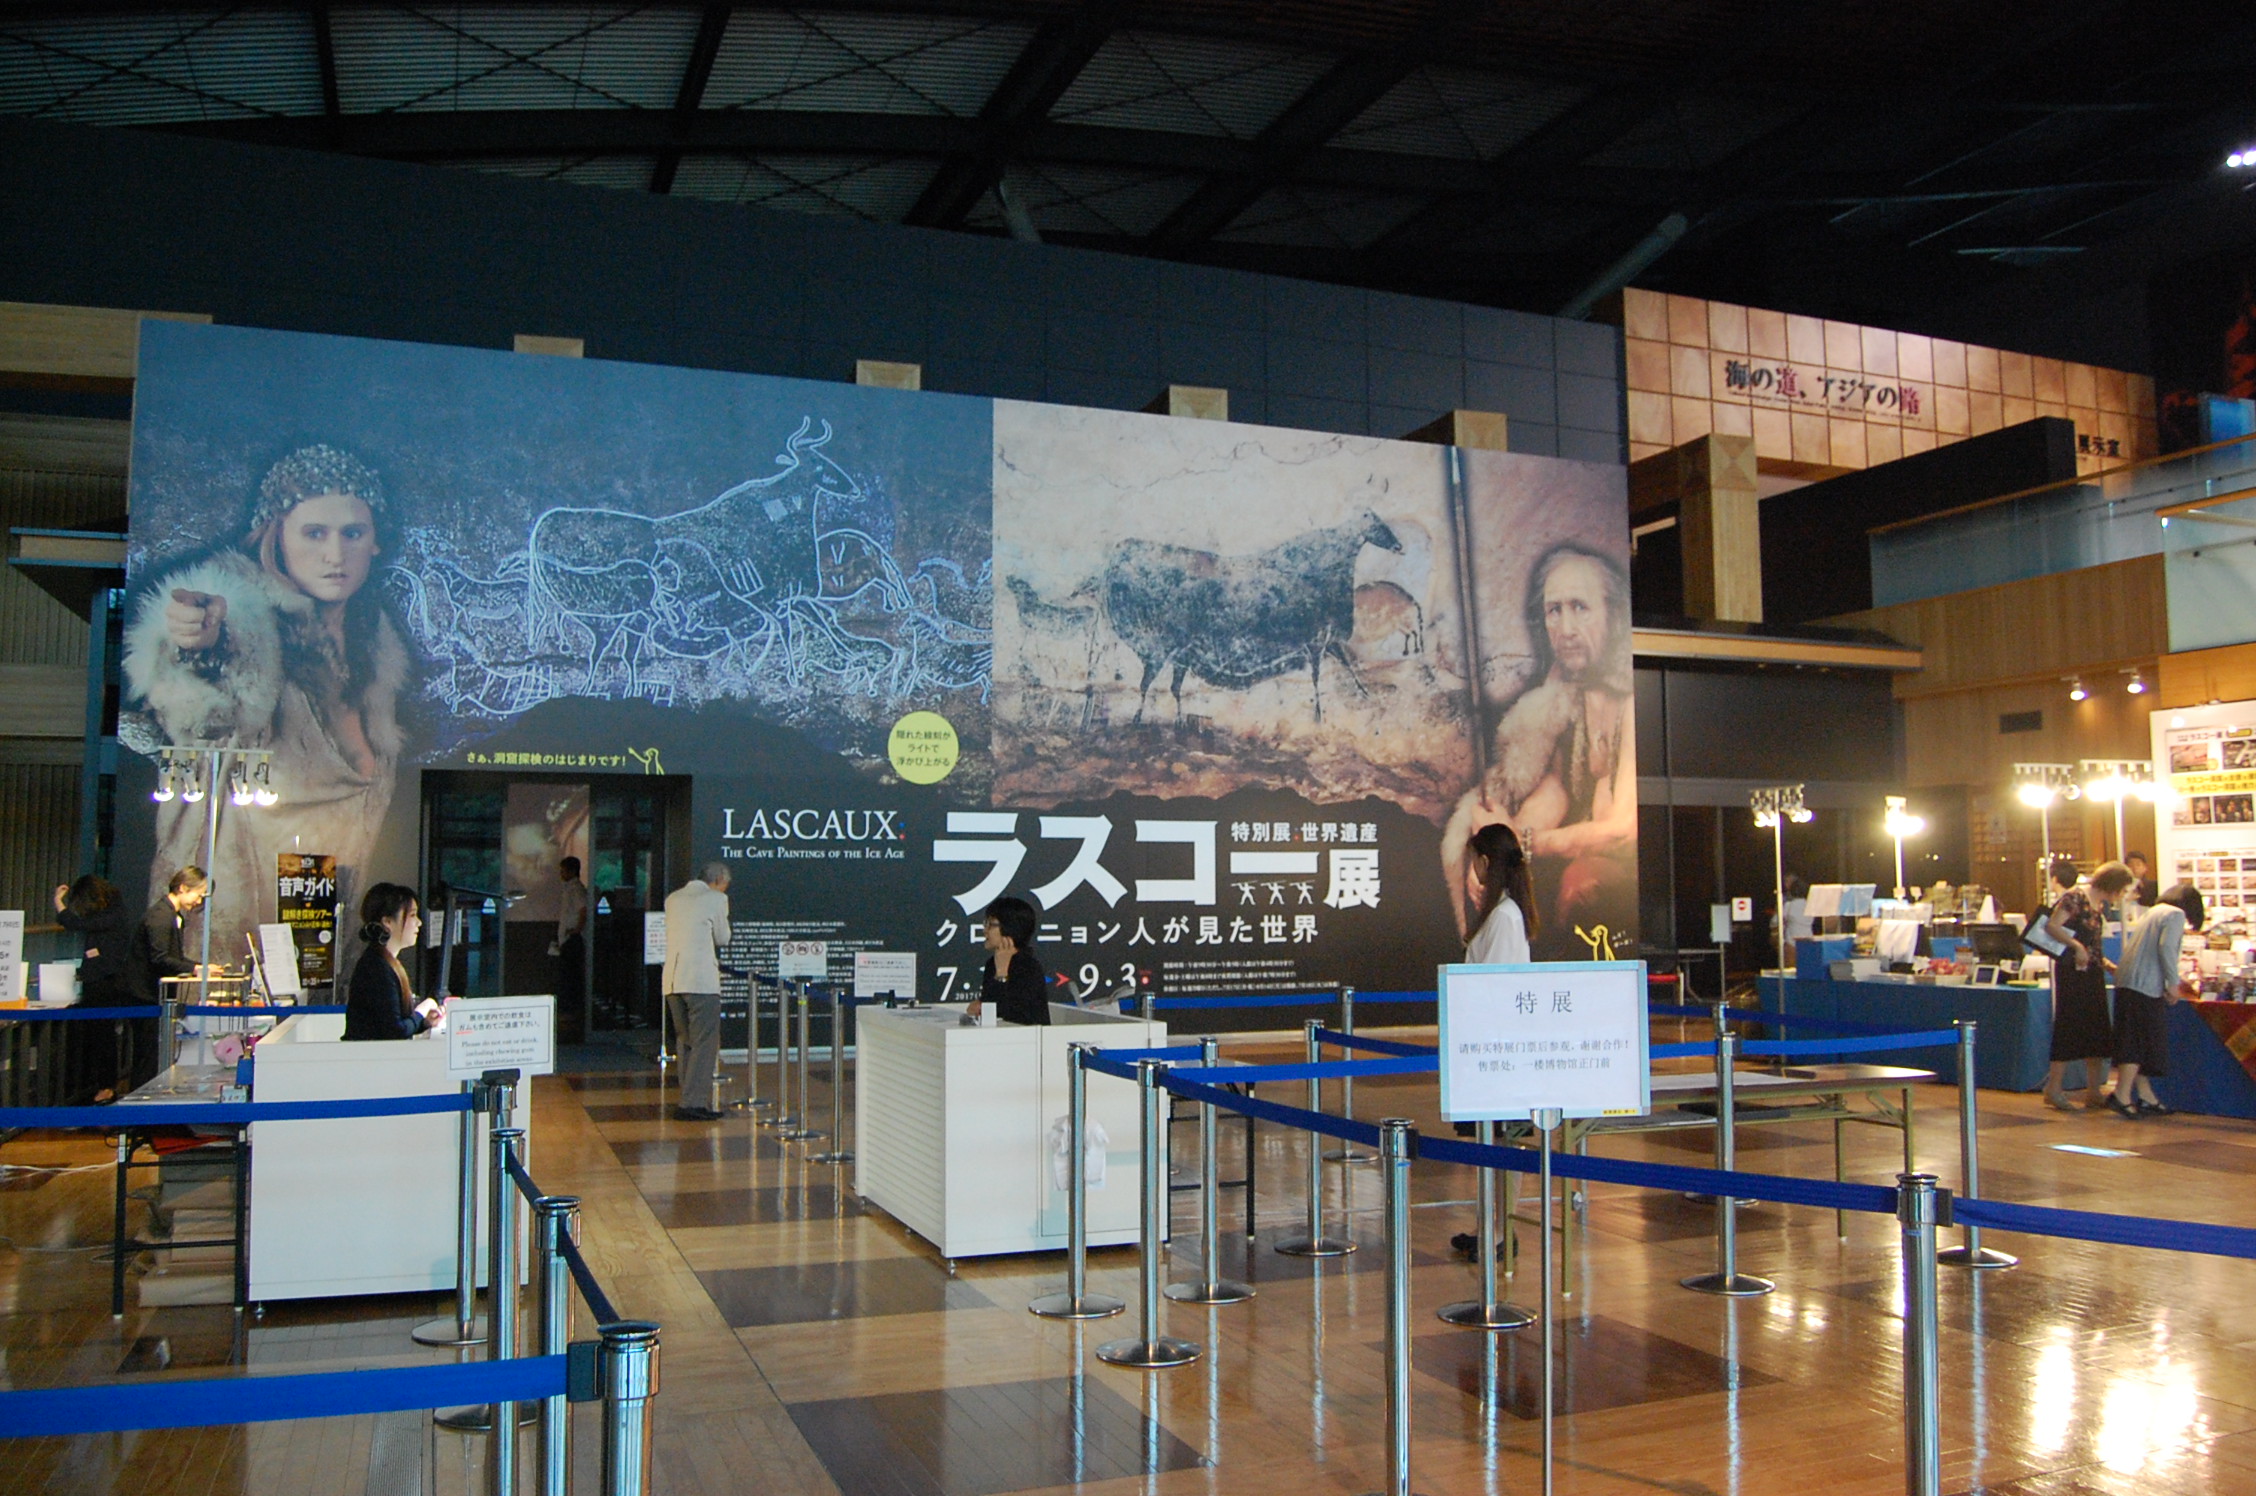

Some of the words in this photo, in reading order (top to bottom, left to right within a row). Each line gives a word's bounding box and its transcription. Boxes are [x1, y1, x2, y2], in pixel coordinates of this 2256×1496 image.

[896, 730, 951, 740] 隠れた線刻が
[908, 743, 940, 754] ライトで
[896, 756, 951, 767] 浮かび上がる
[933, 811, 1381, 917] ラスコー展
[279, 877, 334, 897] 音声ガイド
[936, 915, 1319, 949] クロニョン人が見た世界
